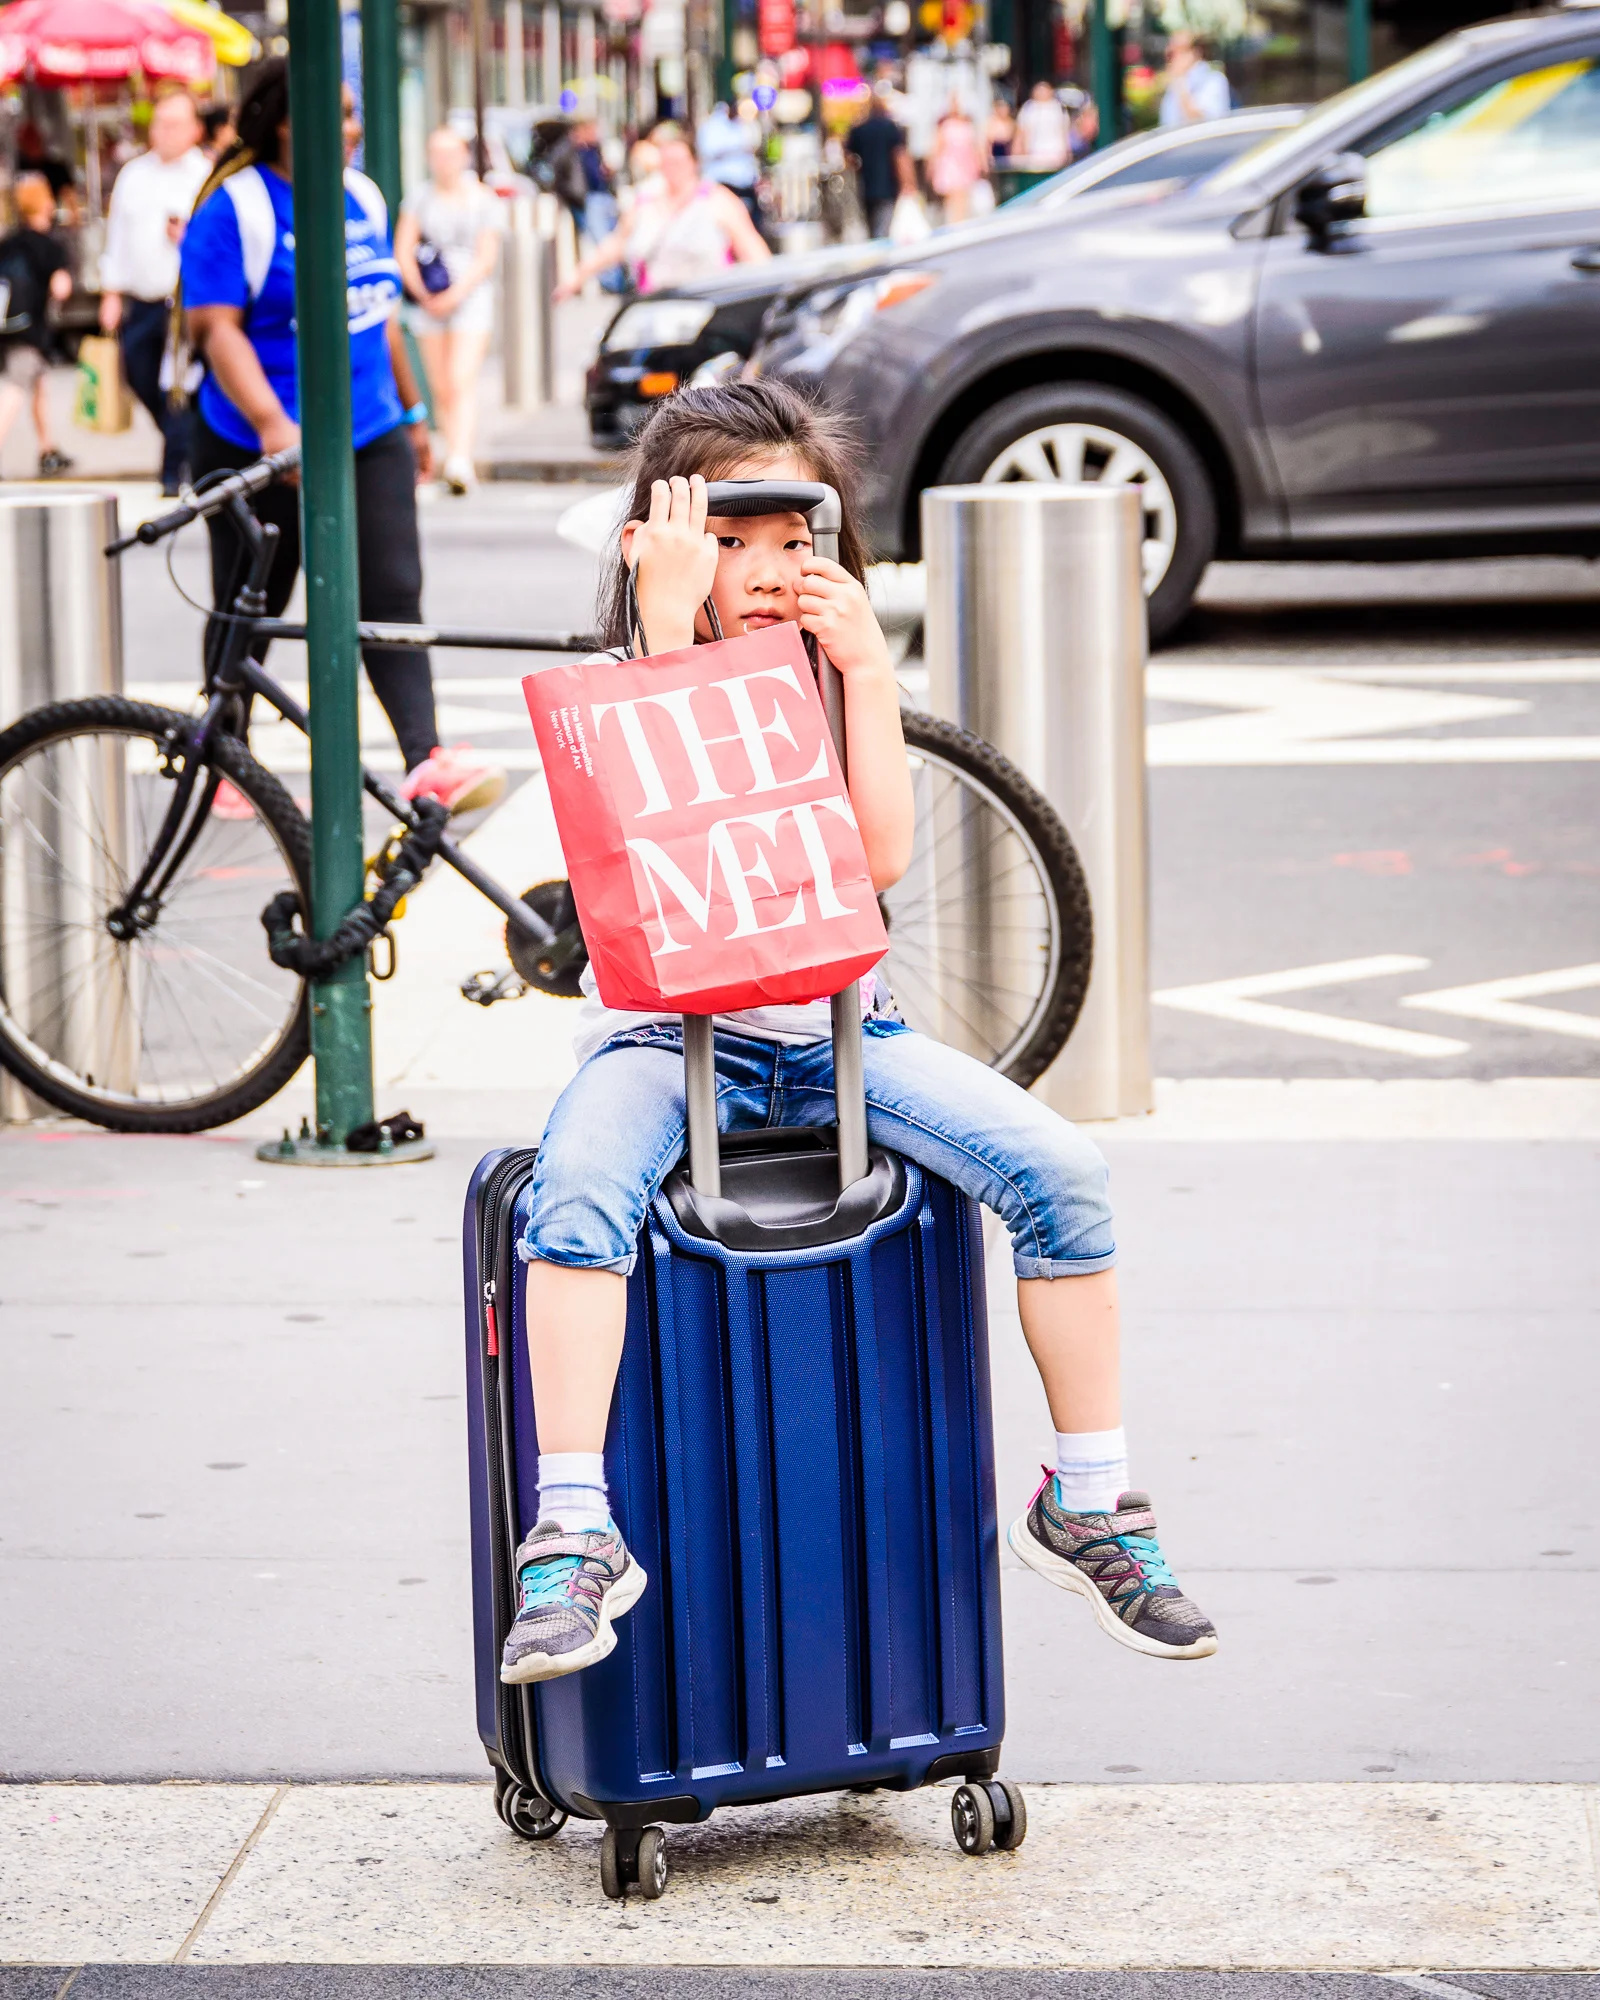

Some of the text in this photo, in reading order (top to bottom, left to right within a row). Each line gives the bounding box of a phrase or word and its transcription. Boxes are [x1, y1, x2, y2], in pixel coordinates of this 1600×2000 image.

[549, 710, 567, 749] New York
[559, 707, 582, 770] Museum of Art
[570, 705, 594, 777] The Metropolitan
[591, 664, 829, 818] THE
[625, 793, 859, 957] MET
